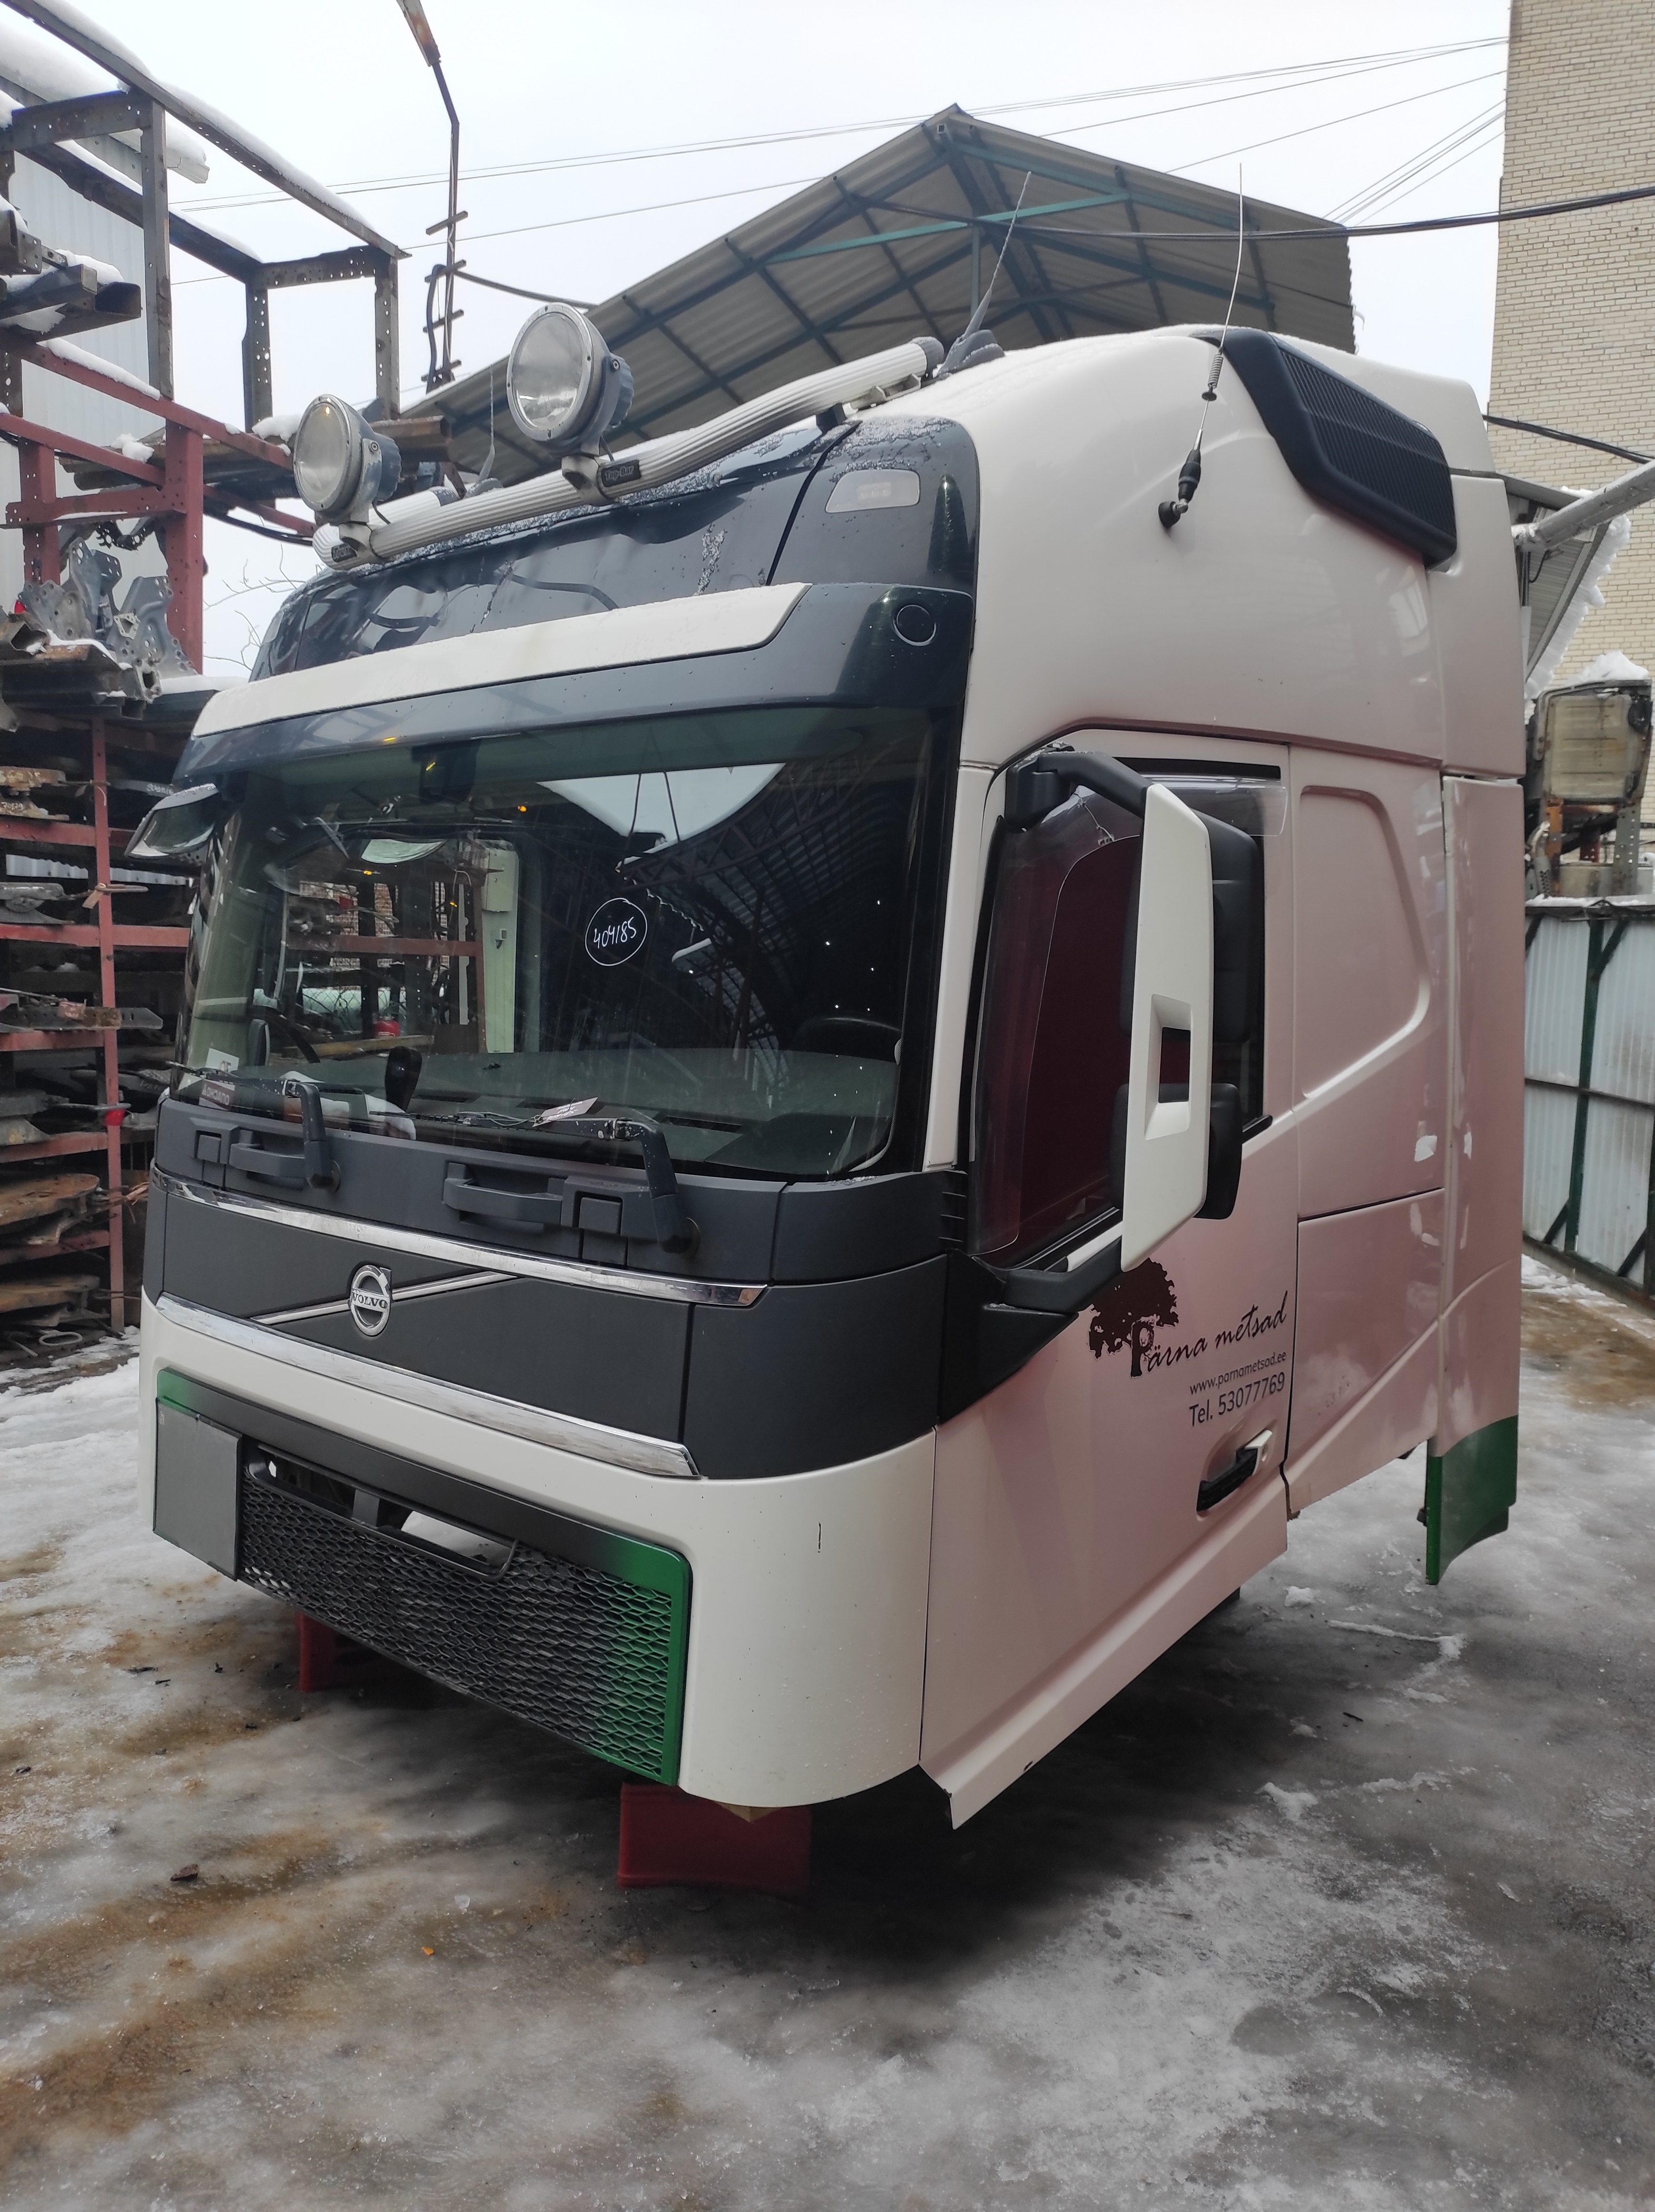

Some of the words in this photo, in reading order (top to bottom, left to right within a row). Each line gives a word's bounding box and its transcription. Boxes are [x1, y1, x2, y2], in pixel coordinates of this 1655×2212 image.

[593, 916, 636, 949] 404185
[352, 1292, 388, 1309] VOLVO
[1216, 1290, 1288, 1349] metsad
[1190, 1351, 1287, 1395] www.parnametsad.ee
[1189, 1399, 1214, 1427] Tel.
[1218, 1371, 1286, 1416] 53077769
